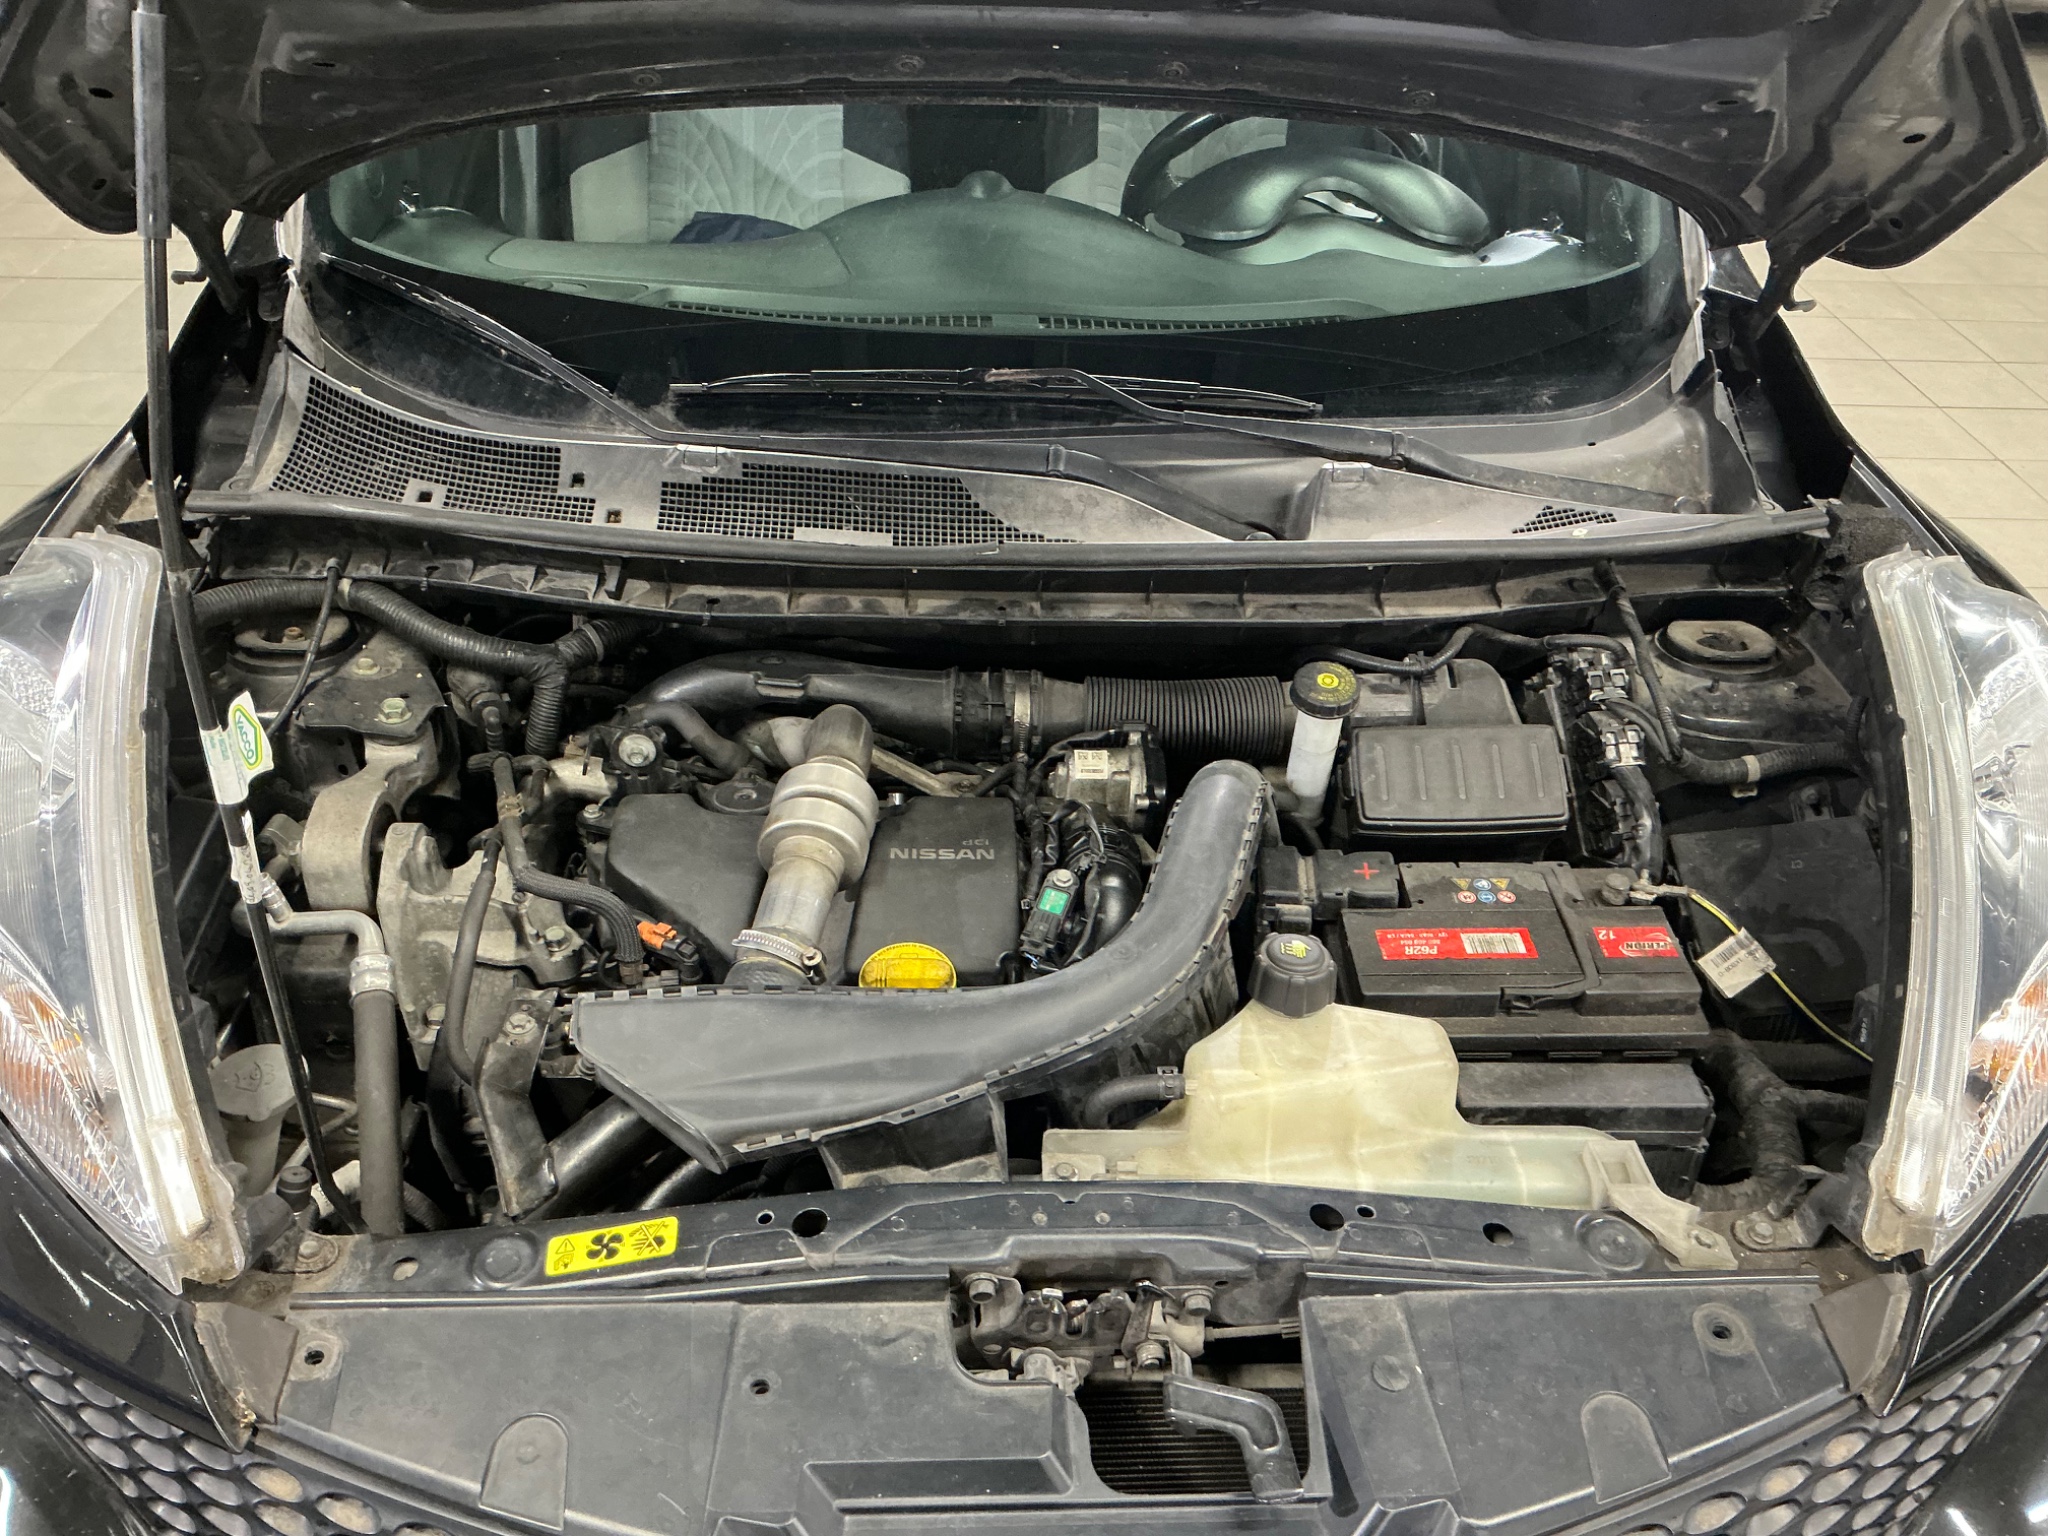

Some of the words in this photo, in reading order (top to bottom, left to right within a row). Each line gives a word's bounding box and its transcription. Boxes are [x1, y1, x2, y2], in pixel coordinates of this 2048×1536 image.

[236, 715, 254, 759] YACCO
[890, 847, 995, 860] NISSAN
[1598, 930, 1616, 940] 12
[1404, 946, 1438, 955] P62R
[1625, 942, 1668, 950] PERION
